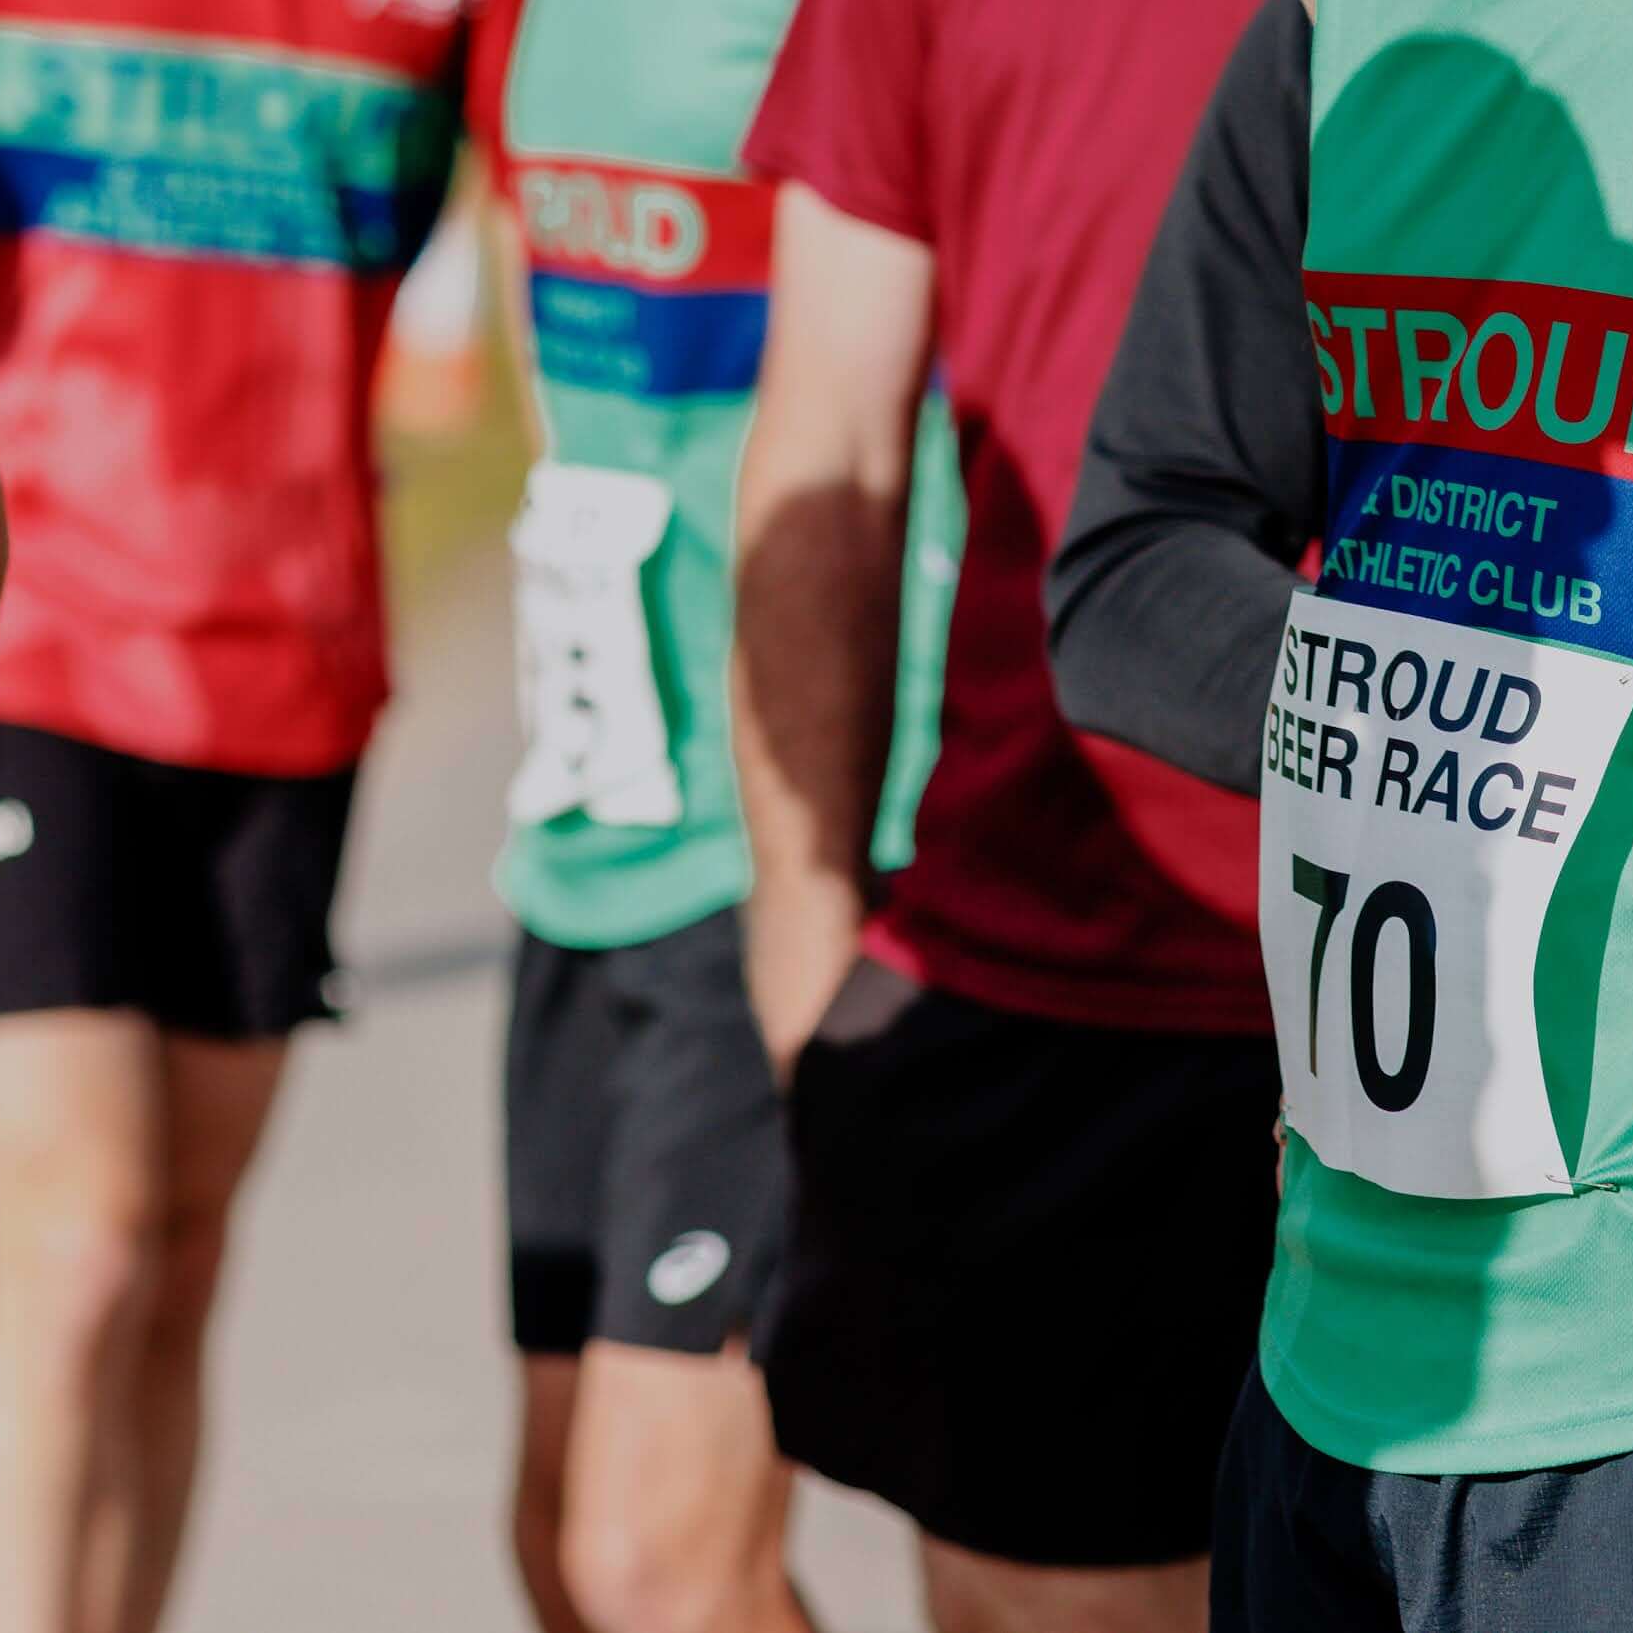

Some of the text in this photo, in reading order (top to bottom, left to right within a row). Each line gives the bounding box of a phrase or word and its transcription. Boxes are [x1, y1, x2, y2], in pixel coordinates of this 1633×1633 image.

[1391, 474, 1558, 543] DISTRICT
[1469, 559, 1603, 626] CLUB
[1284, 624, 1542, 745] STROUD
[1267, 702, 1577, 845] BEER RACE
[1292, 853, 1437, 1112] 70
